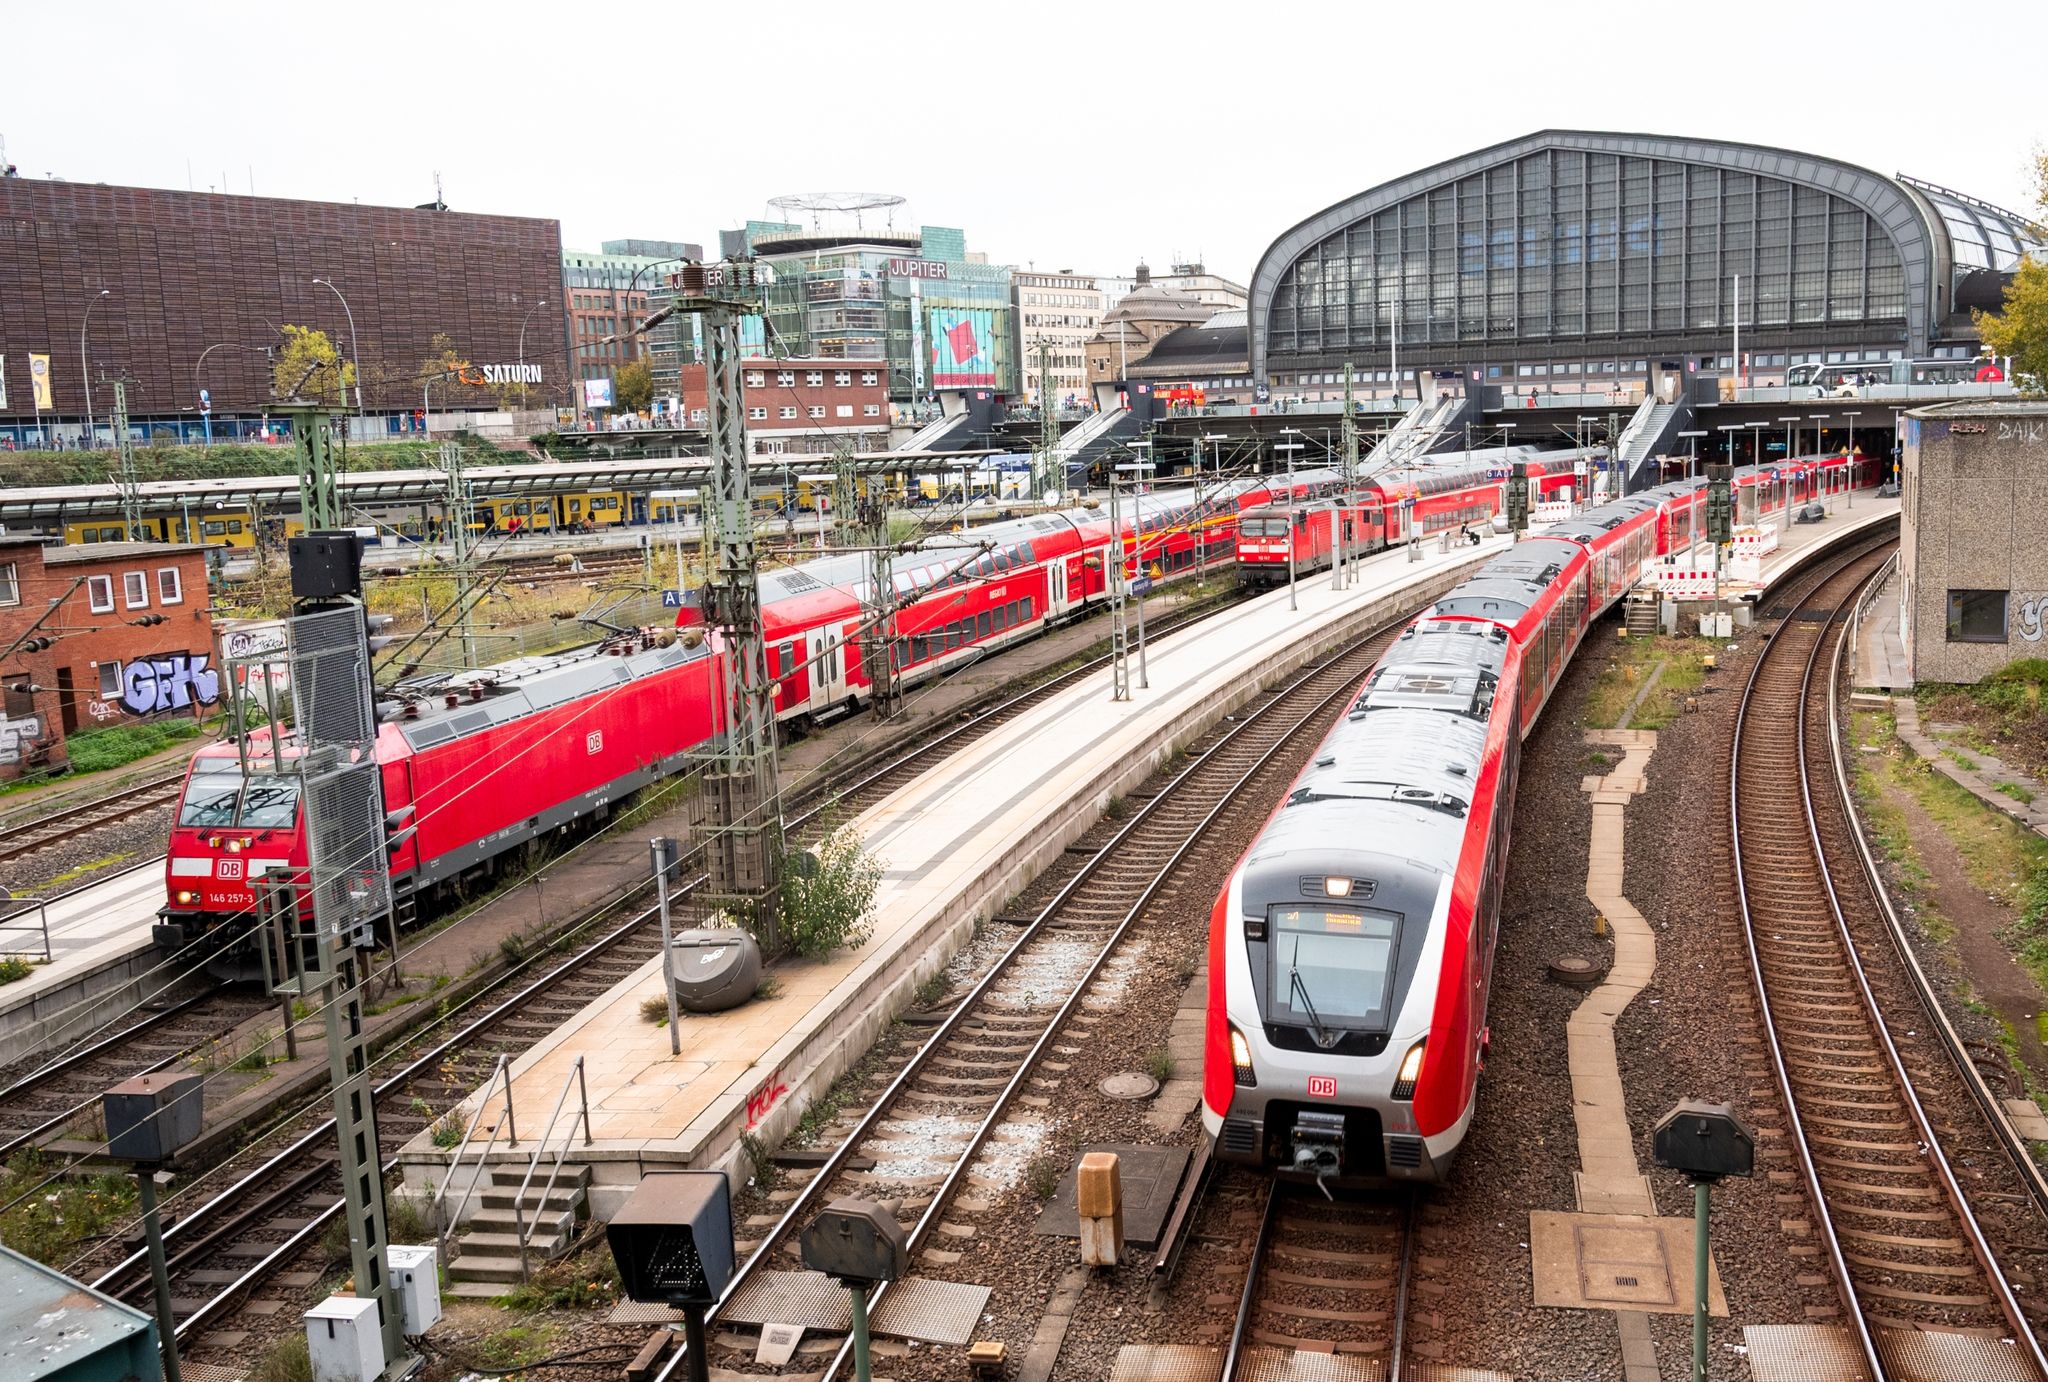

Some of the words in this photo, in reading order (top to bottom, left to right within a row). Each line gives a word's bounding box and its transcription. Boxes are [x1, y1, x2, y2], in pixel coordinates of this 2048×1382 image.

[891, 260, 946, 278] JUPITER
[483, 364, 543, 383] SATURN
[1771, 471, 1777, 479] 4
[1798, 471, 1804, 479] 3
[665, 591, 676, 605] A
[221, 863, 239, 876] DB
[209, 893, 225, 903] 146
[227, 893, 253, 903] 257-3
[1311, 1079, 1333, 1094] DB
